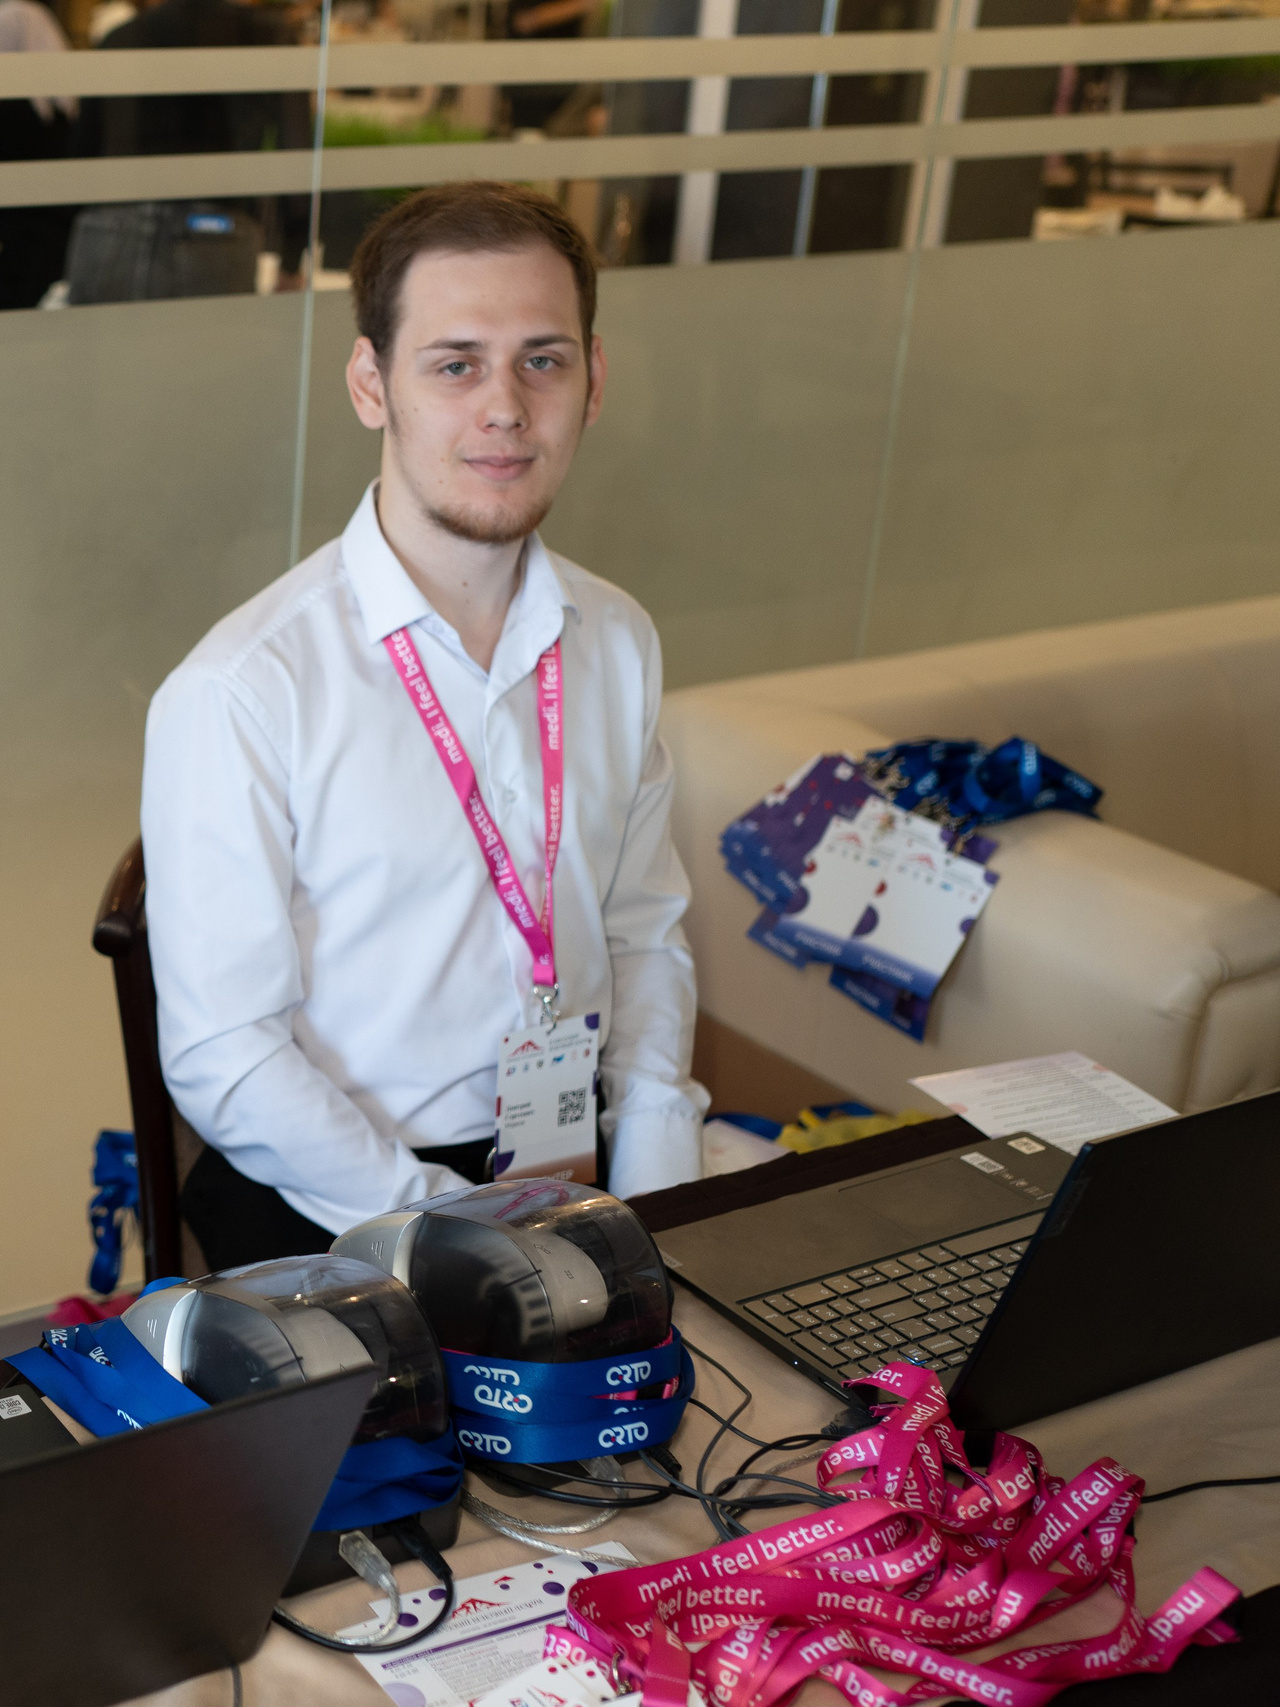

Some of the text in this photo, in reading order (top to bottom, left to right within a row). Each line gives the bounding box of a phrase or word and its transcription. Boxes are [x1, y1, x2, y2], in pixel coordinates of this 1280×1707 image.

[390, 627, 422, 678] bette
[541, 655, 559, 692] feel
[409, 676, 437, 711] feel
[430, 719, 463, 765] medi.
[542, 701, 559, 750] medi.
[469, 790, 500, 851] better.
[490, 848, 510, 879] feel
[503, 884, 535, 929] medi.
[598, 1421, 649, 1449] ORTO
[902, 1401, 940, 1431] medi.
[458, 1429, 512, 1455] ORTO
[823, 1438, 879, 1475] I feel
[1028, 1470, 1115, 1565] medi. I feel
[699, 1561, 710, 1578] I
[711, 1542, 760, 1577] feel
[757, 1518, 844, 1561] better.
[828, 1564, 880, 1583] feel
[881, 1529, 942, 1580] bette
[686, 1584, 766, 1609] better.
[816, 1590, 889, 1619] medi.
[895, 1605, 905, 1622] I
[910, 1607, 961, 1629] feel
[868, 1635, 918, 1668] feel
[920, 1654, 1014, 1706] better.
